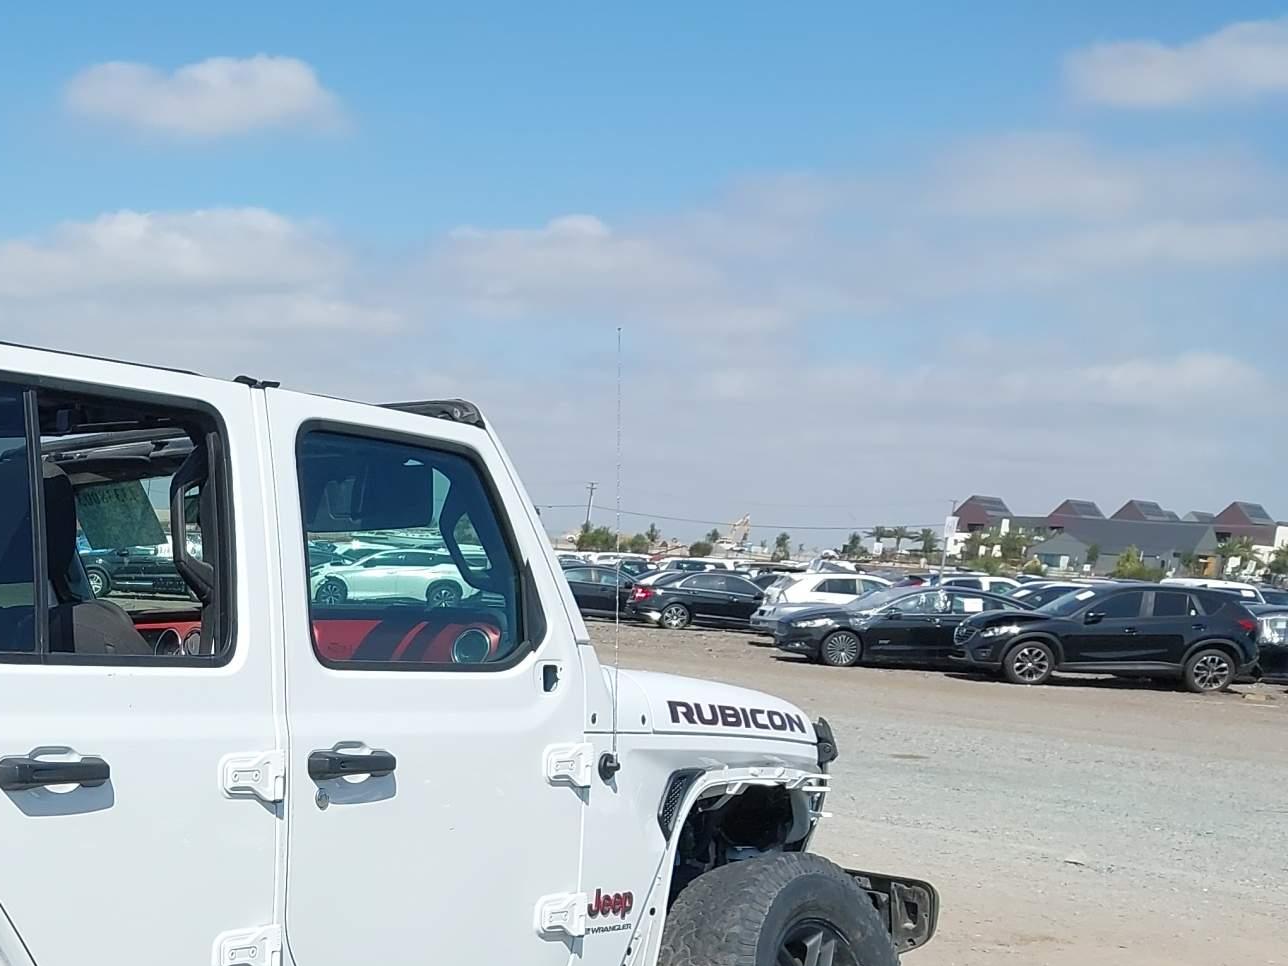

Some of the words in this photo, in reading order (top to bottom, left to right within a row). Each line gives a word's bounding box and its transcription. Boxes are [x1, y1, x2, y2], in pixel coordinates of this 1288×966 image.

[667, 700, 807, 734] RUBICON
[587, 888, 634, 919] Jeep
[591, 923, 632, 935] WRANGLER
